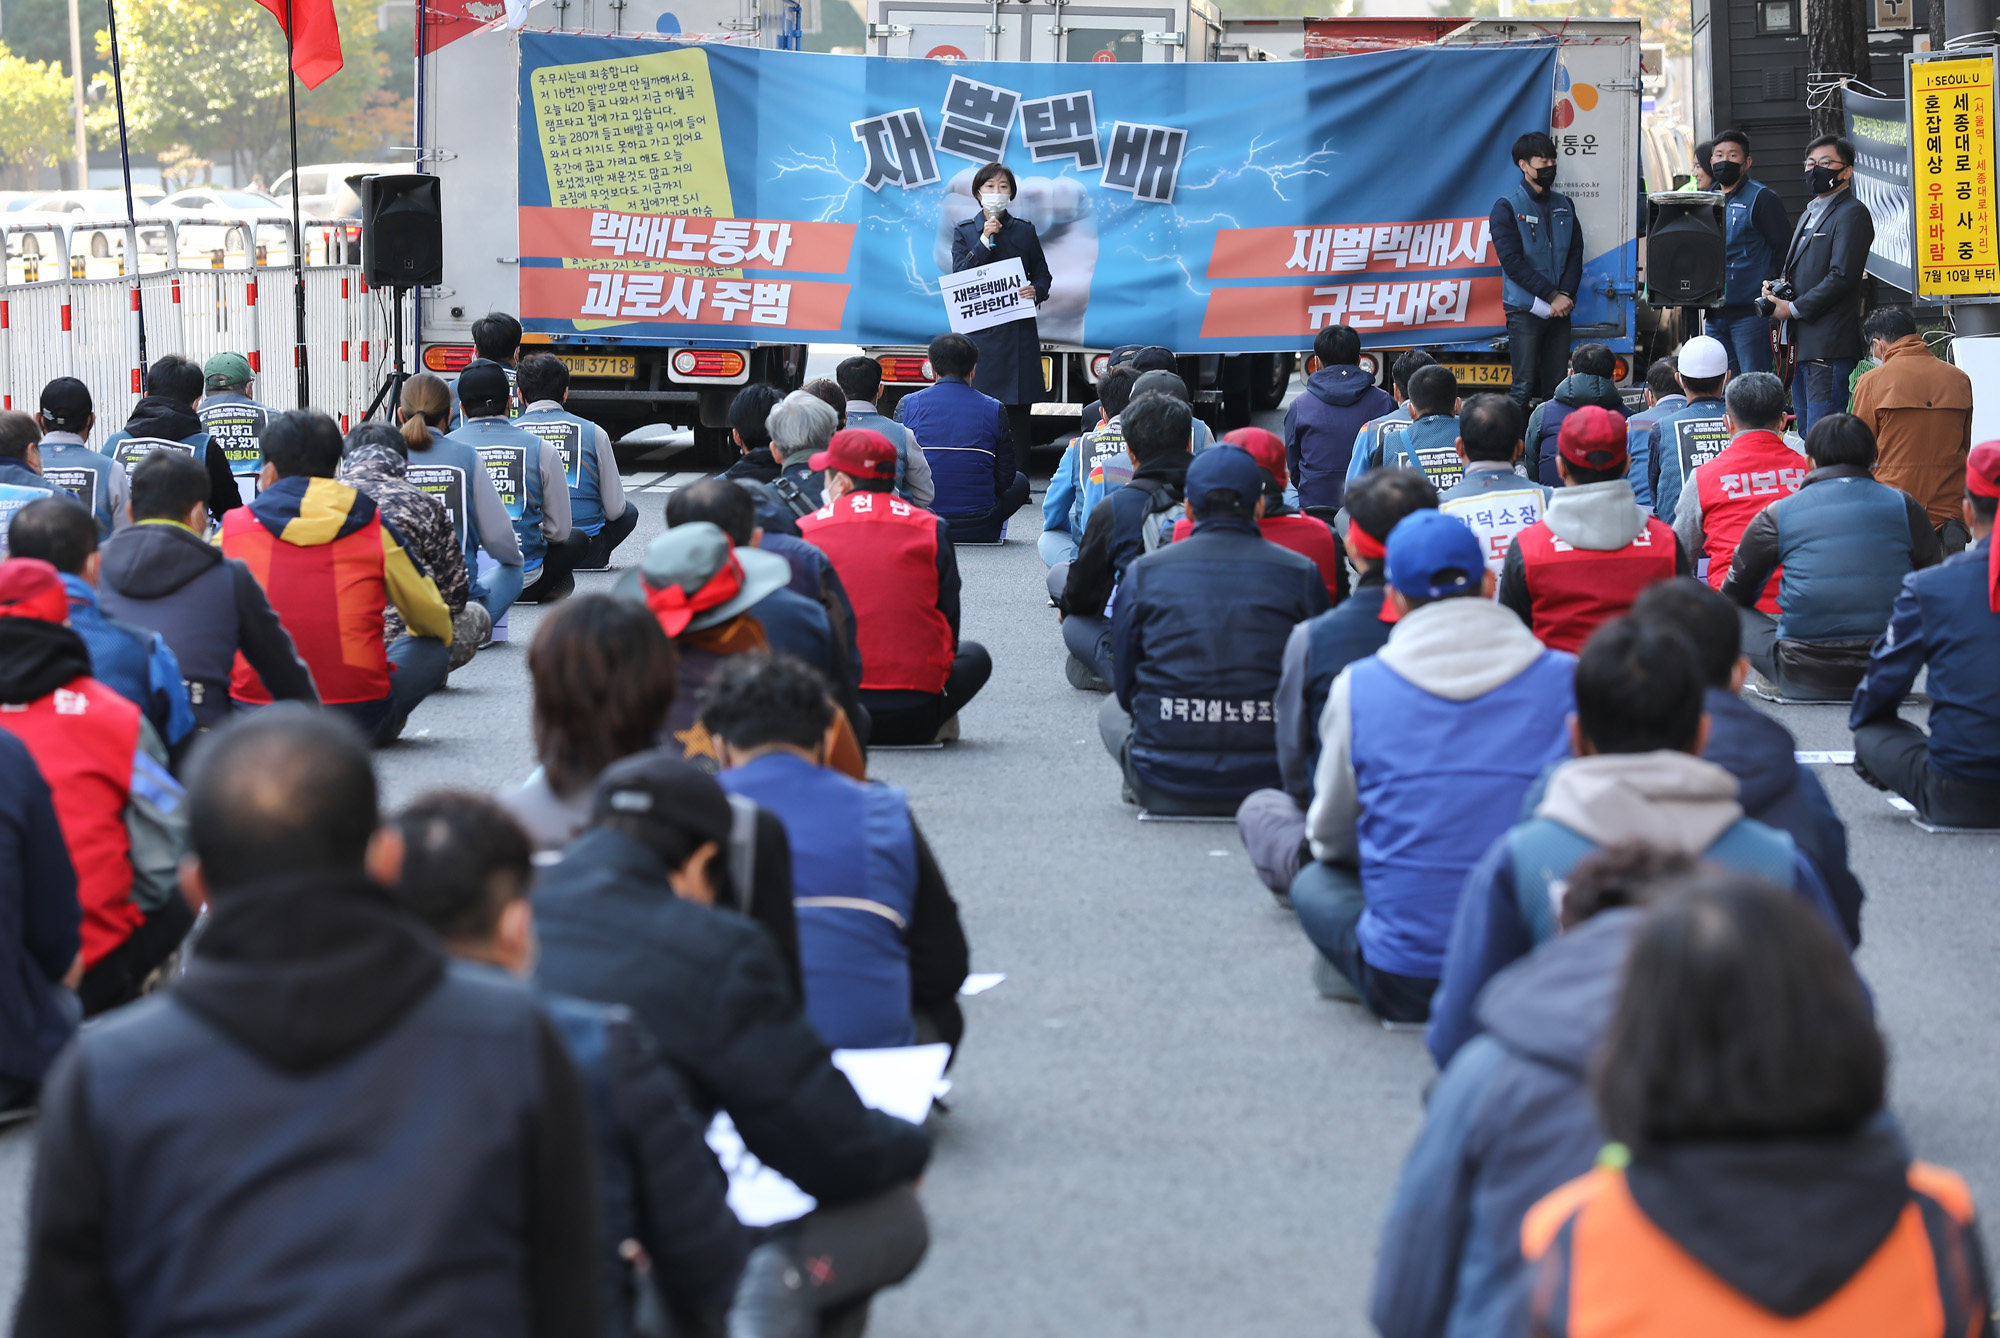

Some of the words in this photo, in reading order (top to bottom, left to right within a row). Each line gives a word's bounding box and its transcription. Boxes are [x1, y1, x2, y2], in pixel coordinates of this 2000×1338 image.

[538, 71, 587, 85] 주무시는데
[590, 64, 640, 80] 죄송합니다
[540, 90, 550, 100] 저
[554, 85, 585, 100] 16번지
[587, 80, 628, 96] 안받으면
[630, 72, 695, 90] 안될까해서요.
[544, 104, 562, 117] 오늘
[565, 101, 585, 112] 420
[588, 100, 607, 112] 들고
[610, 94, 640, 107] 나와서
[642, 90, 662, 104] 지금
[664, 86, 695, 100] 하월곡
[546, 117, 584, 132] 램프타고
[588, 114, 608, 127] 집에
[610, 112, 630, 122] 가고
[632, 104, 677, 122] 있습니다.
[548, 134, 567, 146] 오늘
[570, 130, 599, 144] 280개
[602, 128, 622, 142] 들고
[656, 118, 684, 132] 9시에
[687, 116, 706, 130] 들어
[1974, 97, 1986, 140] (서울역
[550, 148, 570, 158] 와서
[572, 147, 582, 156] 다
[618, 138, 647, 154] 못하고
[650, 137, 670, 146] 가고
[672, 132, 703, 146] 있어요
[850, 74, 1188, 204] 재벌택배
[1924, 94, 1943, 175] 혼잡예상
[1953, 93, 1972, 172] 세종대로
[554, 162, 582, 176] 중간에
[607, 156, 637, 167] 가려고
[640, 153, 660, 163] 해도
[664, 149, 682, 162] 오늘
[556, 174, 604, 190] 보셨겠지만
[650, 167, 670, 180] 많고
[673, 163, 692, 174] 거의
[590, 186, 639, 201] 무엇보다도
[642, 180, 682, 194] 지금까지
[628, 201, 637, 210] 저
[640, 195, 680, 212] 집에가면
[683, 192, 699, 204] 5시
[1976, 160, 1989, 254] 세종대로사거리)
[1927, 182, 1946, 262] 우회바람
[590, 212, 792, 266] 택배노동자
[1285, 220, 1493, 272] 재벌택배사
[953, 274, 1022, 304] 재벌택배사
[1924, 270, 1942, 284] 7월
[1946, 268, 1970, 282] 10일
[1974, 268, 1996, 282] 부터
[580, 272, 706, 320] 과로사
[710, 281, 792, 326] 주범
[960, 292, 1019, 320] 규탄한다!
[1308, 280, 1471, 330] 규탄대회
[558, 358, 584, 372] 0배
[588, 358, 629, 374] 3718
[1470, 366, 1511, 382] 1347
[226, 437, 237, 448] 수
[238, 437, 260, 449] 있게
[231, 425, 253, 436] 않고
[1095, 442, 1118, 453] 죽지
[1696, 440, 1719, 452] 죽지
[1720, 468, 1806, 500] 진보당
[1160, 697, 1279, 722] 전국건설노동조
